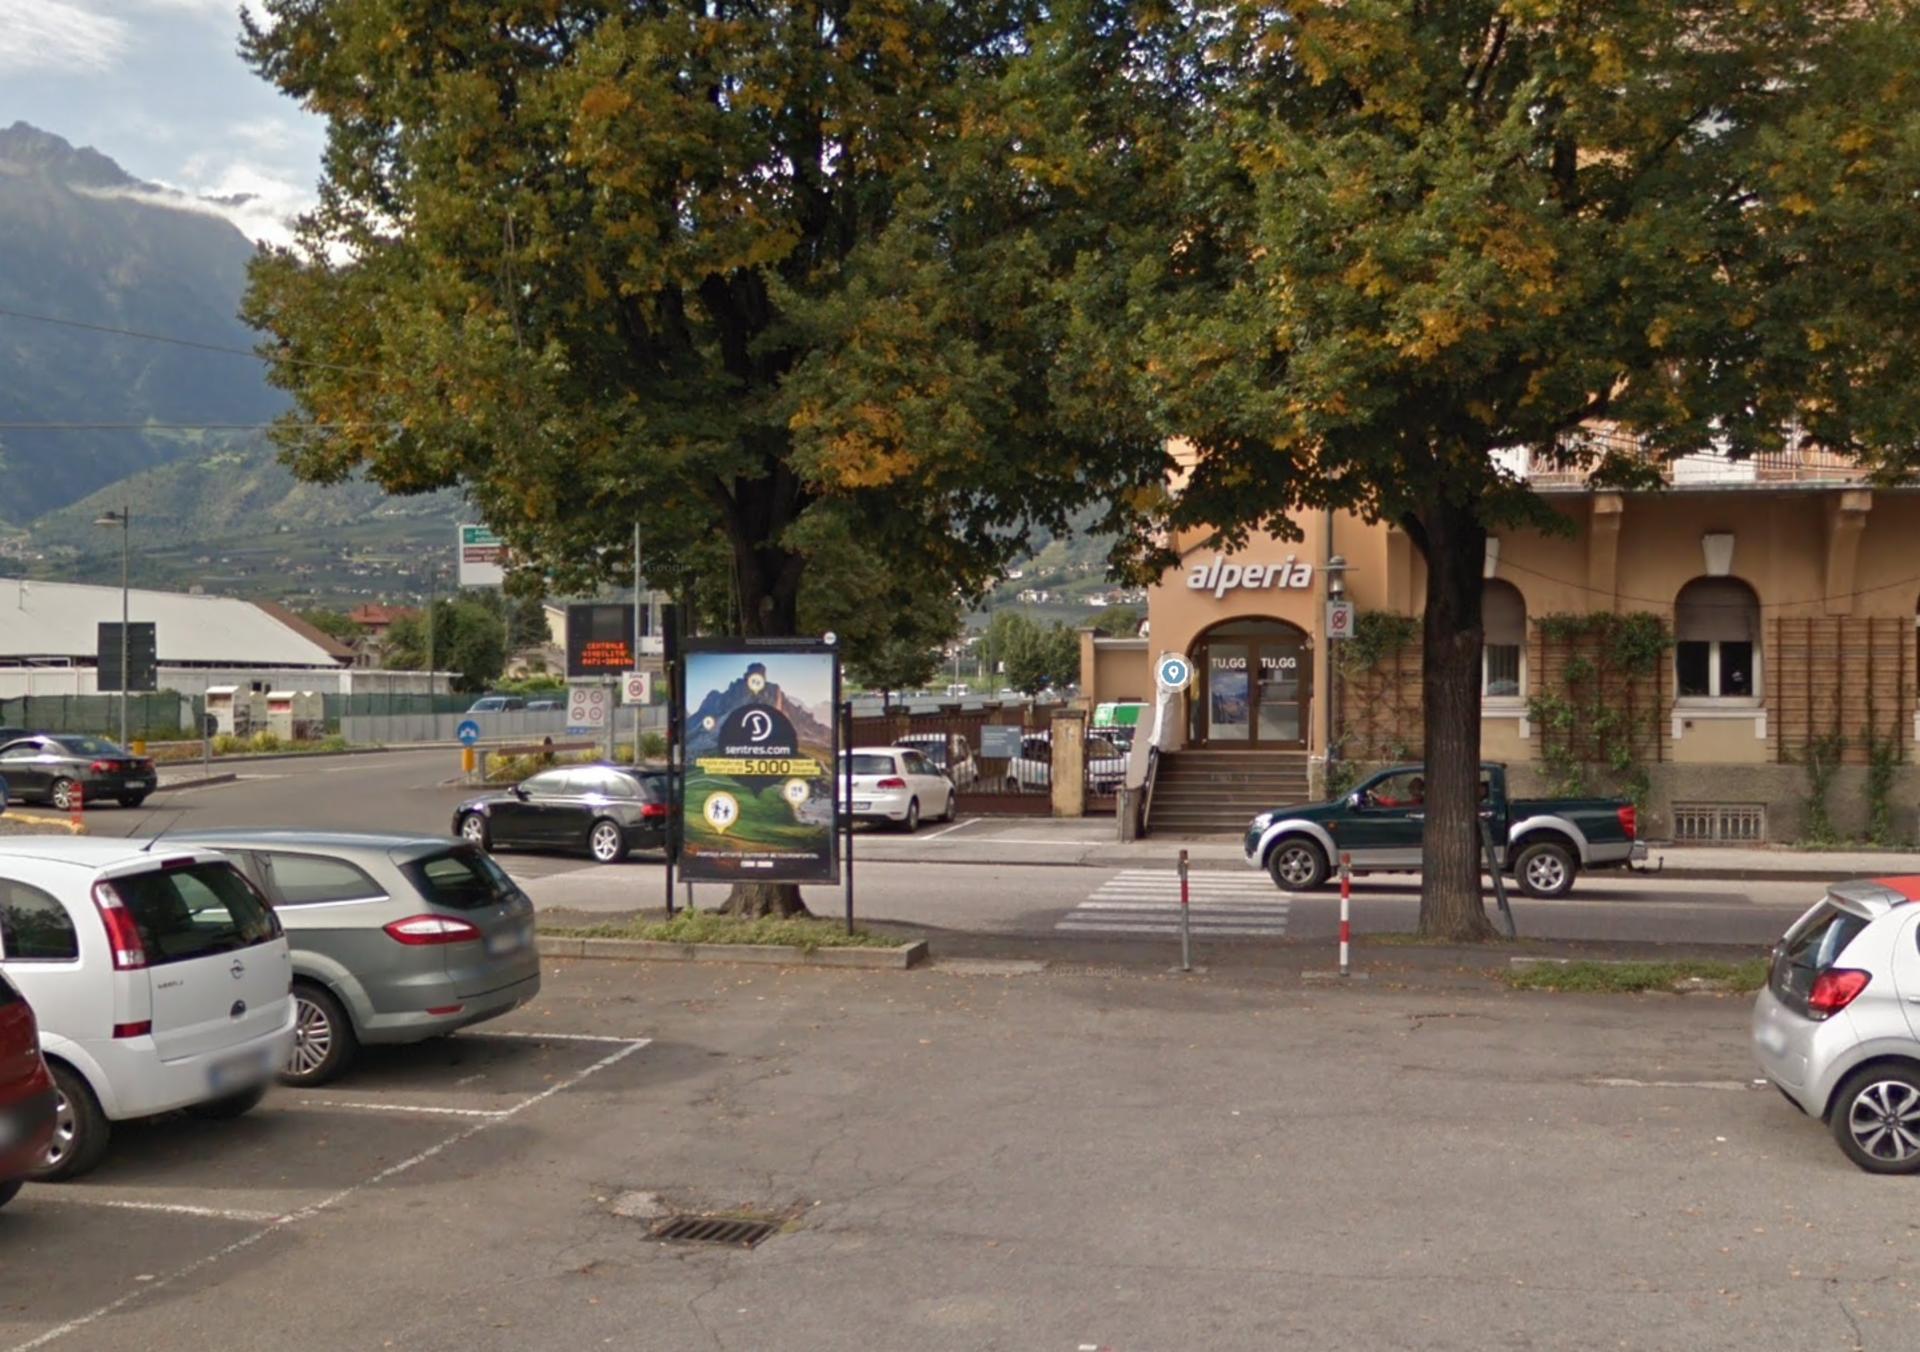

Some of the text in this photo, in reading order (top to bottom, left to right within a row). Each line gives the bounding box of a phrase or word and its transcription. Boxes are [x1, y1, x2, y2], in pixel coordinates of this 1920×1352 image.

[1187, 555, 1313, 598] alperia
[725, 745, 791, 755] sentres.com
[744, 759, 791, 775] 5.000
